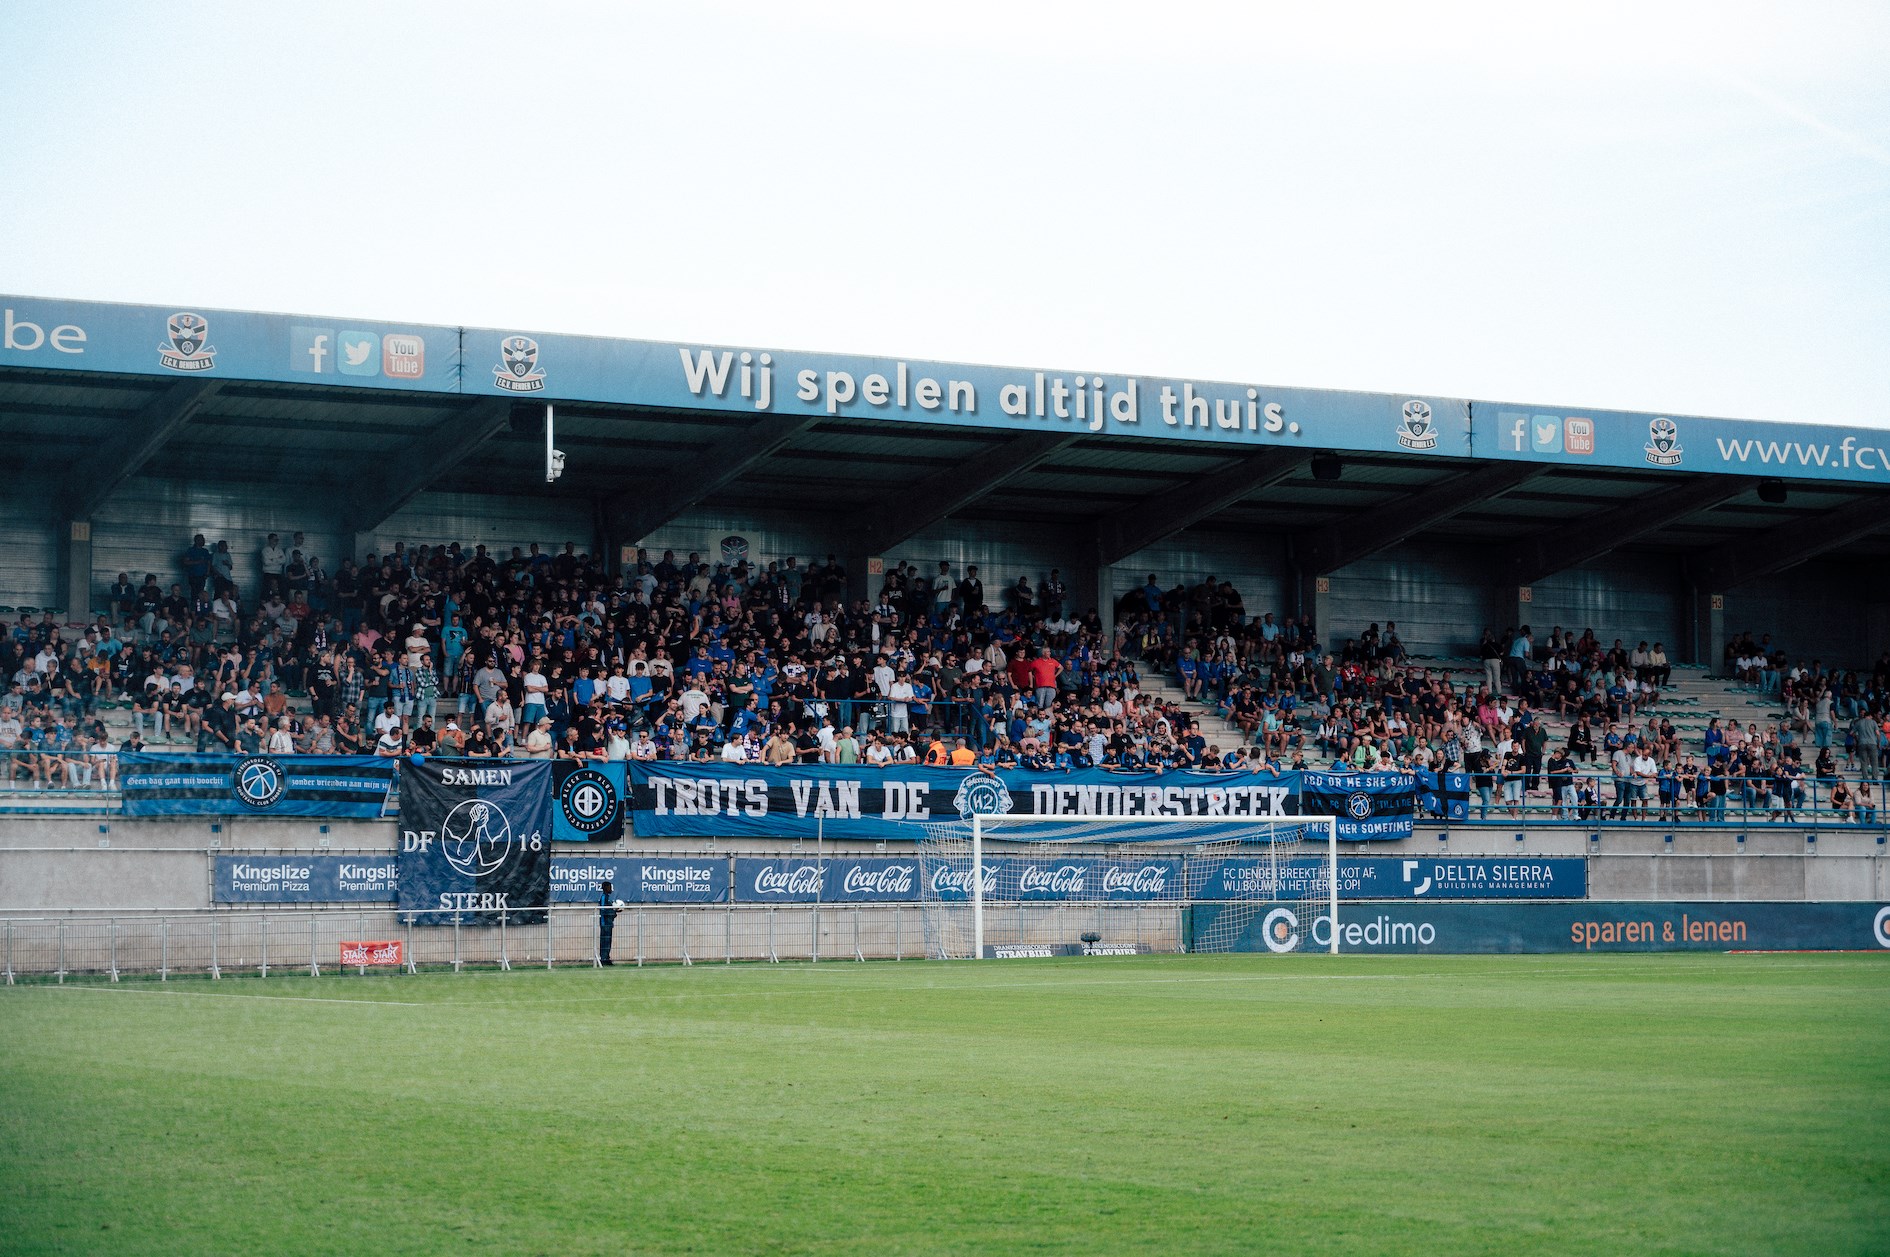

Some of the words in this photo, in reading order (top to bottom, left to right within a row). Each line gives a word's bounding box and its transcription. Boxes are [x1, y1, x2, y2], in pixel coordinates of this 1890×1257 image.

[4, 309, 87, 353] be
[393, 340, 414, 355] You
[390, 354, 418, 374] Tube
[679, 348, 771, 410] Wij
[796, 362, 976, 414] spelen
[999, 372, 1137, 431] altijd
[1160, 382, 1300, 434] thuis.
[1571, 422, 1587, 435] You
[1569, 436, 1590, 450] Tube
[869, 560, 882, 573] H2
[1317, 580, 1329, 592] H3
[1520, 589, 1531, 601] H3
[1711, 598, 1722, 609] H3
[127, 777, 147, 786] Geen
[149, 777, 163, 786] dag
[165, 778, 180, 786] gaat
[182, 777, 195, 786] mij
[197, 777, 223, 786] voorbij
[441, 768, 513, 786] SAMEN
[1329, 777, 1341, 787] OR
[1346, 777, 1361, 788] ME
[1366, 777, 1386, 788] SHE
[1390, 775, 1414, 787] SAID
[292, 778, 315, 787] zonder
[316, 779, 347, 788] vrienden
[349, 780, 361, 788] aan
[364, 781, 379, 790] mijn
[648, 776, 768, 817] TROTS
[790, 780, 862, 819] VAN
[882, 781, 930, 820] DE
[1031, 783, 1290, 816] DENDERSTREEK
[1338, 823, 1357, 834] HER
[403, 831, 436, 852] DF
[518, 830, 543, 852] 18
[232, 864, 311, 883] Kingslize
[641, 866, 712, 884] Kingslize
[1223, 868, 1236, 879] FC
[1280, 868, 1317, 879] BREEKT
[1341, 867, 1360, 879] KOT
[1362, 867, 1377, 880] AF,
[1435, 865, 1487, 881] DELTA
[1492, 865, 1553, 881] SIERRA
[232, 881, 279, 892] Premium
[282, 881, 309, 892] Pizza
[339, 881, 384, 891] Premium
[549, 882, 586, 892] remium
[641, 882, 683, 892] Premium
[686, 882, 711, 892] Pizza
[1222, 880, 1240, 891] WIJ
[1243, 880, 1286, 891] BOUWEN
[1288, 880, 1307, 891] HET
[1309, 880, 1343, 891] TERG
[1344, 879, 1361, 891] OP!
[439, 892, 510, 909] STERK
[1571, 920, 1654, 950] sparen
[1662, 921, 1675, 942] &
[1683, 913, 1747, 942] lenen
[343, 947, 368, 960] STAR
[373, 947, 398, 960] STAR
